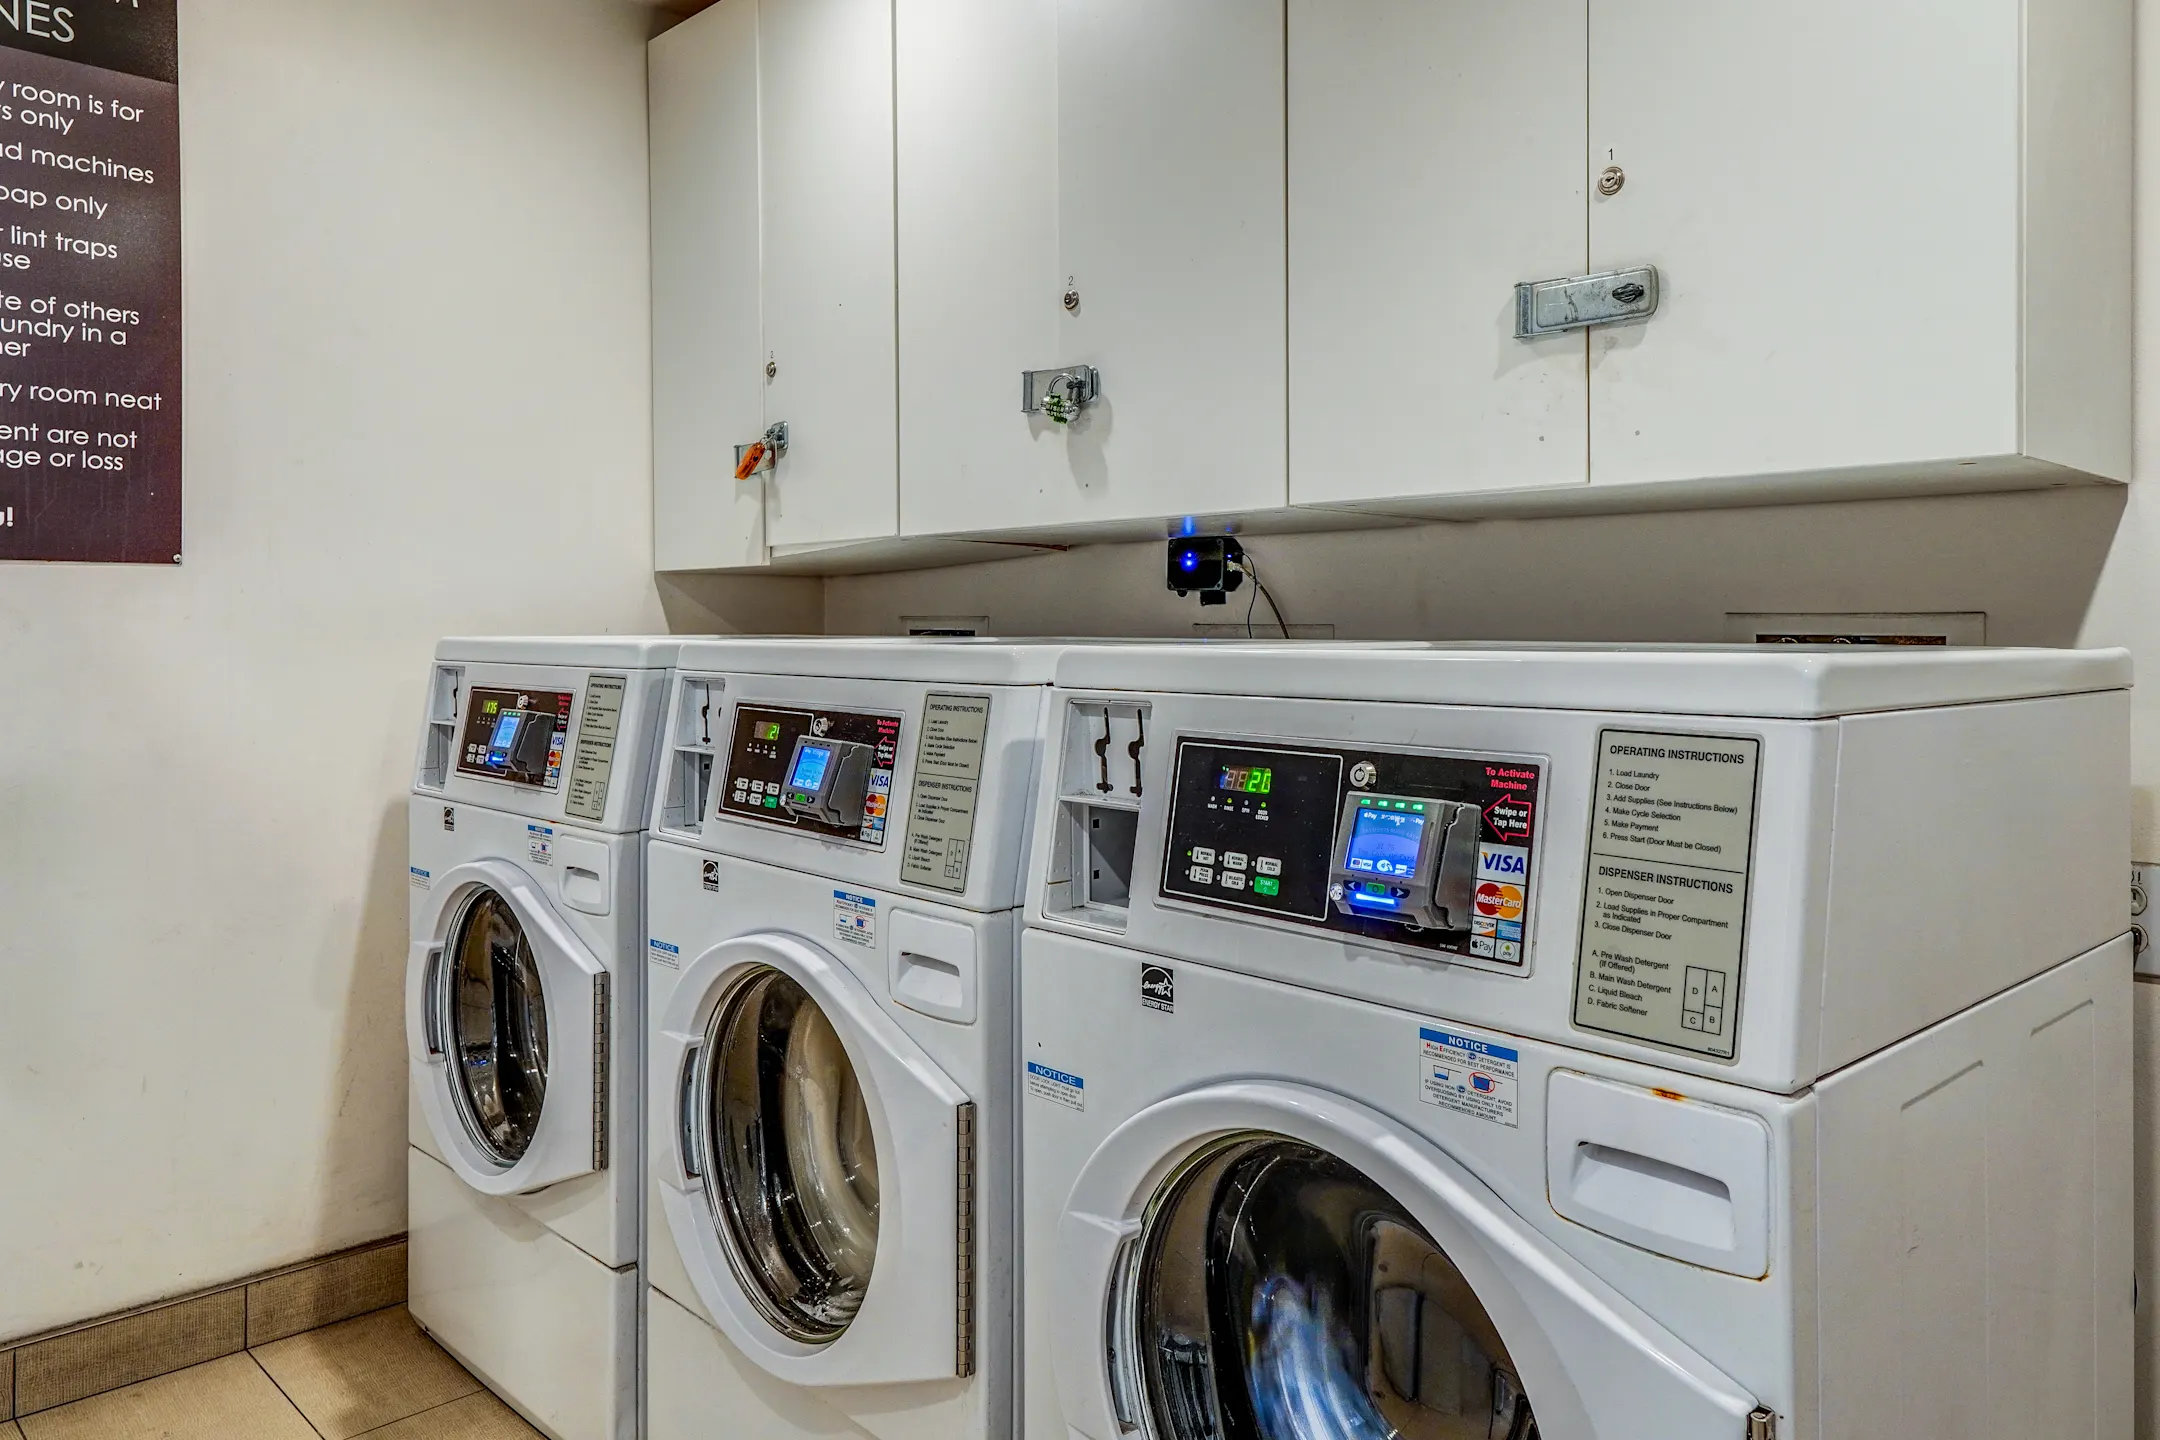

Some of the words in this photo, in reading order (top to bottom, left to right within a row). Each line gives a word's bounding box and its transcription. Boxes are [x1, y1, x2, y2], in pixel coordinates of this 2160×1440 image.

[13, 83, 80, 110] room
[88, 94, 104, 115] is
[111, 100, 144, 122] for
[20, 110, 74, 135] only
[0, 142, 22, 160] d
[31, 148, 154, 183] machines
[1607, 147, 1614, 161] 1
[55, 196, 108, 219] only
[11, 225, 47, 248] lint
[55, 232, 118, 259] traps
[0, 252, 31, 270] se
[1068, 275, 1074, 286] 2
[30, 297, 57, 314] of
[64, 301, 140, 325] others
[1, 317, 75, 343] undry
[82, 322, 102, 342] in
[110, 330, 127, 346] a
[0, 341, 31, 357] er
[30, 385, 97, 405] room
[105, 392, 162, 411] neat
[47, 428, 89, 445] are
[97, 430, 138, 449] not
[0, 449, 41, 468] ge
[49, 452, 75, 468] or
[82, 450, 124, 471] loss
[930, 703, 952, 712] OPERATING
[953, 705, 983, 713] INSTRUCTIONS
[1610, 745, 1665, 758] OPERATING
[1668, 749, 1744, 764] INSTRUCTIONS
[871, 774, 888, 788] VISA
[1486, 767, 1496, 776] To
[1498, 768, 1535, 779] Activate
[1609, 768, 1614, 776] 1.
[1616, 769, 1632, 777] Load
[1634, 770, 1660, 780] Laundry
[918, 780, 940, 789] DISPENSER
[942, 782, 972, 793] INSTRUCTIONS
[1491, 779, 1527, 790] Machine
[1615, 781, 1633, 790] Close
[1635, 783, 1650, 791] Door
[1494, 806, 1517, 818] Swipe
[1519, 809, 1528, 818] or
[1606, 793, 1612, 801] 3.
[1613, 794, 1626, 802] Add
[1628, 795, 1654, 805] Supplies
[1656, 799, 1672, 807] (See
[1674, 800, 1712, 811] Instructions
[1713, 804, 1738, 815] Below)
[1612, 807, 1630, 815] Make
[1631, 809, 1649, 818] Cycle
[1651, 811, 1681, 821] Selection
[1493, 817, 1508, 829] Tap
[1509, 819, 1528, 830] Here
[1611, 820, 1628, 828] Make
[1630, 822, 1659, 832] Payment
[1602, 831, 1608, 839] 6.
[1610, 832, 1628, 841] Press
[1630, 835, 1645, 843] Start
[1647, 836, 1665, 845] (Door
[1666, 840, 1683, 848] Must
[1694, 842, 1721, 854] Closed)
[1482, 851, 1525, 874] VISA
[1599, 866, 1654, 883] DISPENSER
[1656, 873, 1733, 894] INSTRUCTIONS
[846, 894, 863, 903] NOTICE
[1476, 892, 1521, 909] MasterCard
[1605, 888, 1622, 897] Open
[1624, 890, 1656, 901] Dispenser
[1658, 895, 1674, 904] Door
[1474, 920, 1495, 928] DISCOVER
[1603, 902, 1619, 911] Load
[1621, 904, 1648, 915] Supplies
[1658, 910, 1680, 921] Proper
[1681, 914, 1728, 929] Compartment
[1612, 912, 1641, 923] Indicated
[1594, 920, 1600, 928] 3.
[1602, 922, 1620, 931] Close
[1621, 925, 1654, 936] Dispenser
[1656, 931, 1672, 940] Door
[653, 940, 674, 951] NOTICE
[1480, 941, 1493, 953] Pay
[1592, 949, 1598, 957] A.
[1600, 951, 1612, 960] Pre
[1614, 953, 1633, 963] Wash
[1634, 957, 1669, 970] Detergent
[1607, 961, 1635, 974] Offered)
[1589, 970, 1596, 979] B.
[1598, 972, 1614, 982] Main
[1616, 976, 1635, 986] Wash
[1637, 980, 1671, 993] Detergent
[1692, 987, 1698, 995] D
[1711, 985, 1718, 993] A
[1588, 984, 1595, 992] C.
[1597, 986, 1617, 996] Liquid
[1619, 990, 1642, 1001] Bleach
[1142, 998, 1160, 1010] ENERGY
[1160, 1003, 1173, 1012] STAR
[1587, 996, 1594, 1005] D.
[1596, 999, 1617, 1010] Fabric
[1619, 1003, 1648, 1016] Softener
[1690, 1016, 1696, 1024] C
[1709, 1016, 1715, 1024] B
[1448, 1035, 1488, 1054] NOTICE
[1423, 1049, 1456, 1063] RECOMMENDED
[1467, 1060, 1479, 1068] BEST
[1480, 1063, 1515, 1077] PERFORMANCE
[1478, 1056, 1505, 1068] DETERGENT
[1035, 1065, 1076, 1085] NOTICE
[1424, 1085, 1457, 1098] OVERSUDSING
[1466, 1096, 1480, 1104] USING
[1481, 1100, 1494, 1108] ONLY
[1430, 1080, 1444, 1088] USING
[1497, 1099, 1512, 1107] AVOID
[1432, 1093, 1460, 1105] DETERGENT
[1461, 1101, 1503, 1117] MANUFACTURERS
[1438, 1101, 1474, 1115] RECOMMENDED
